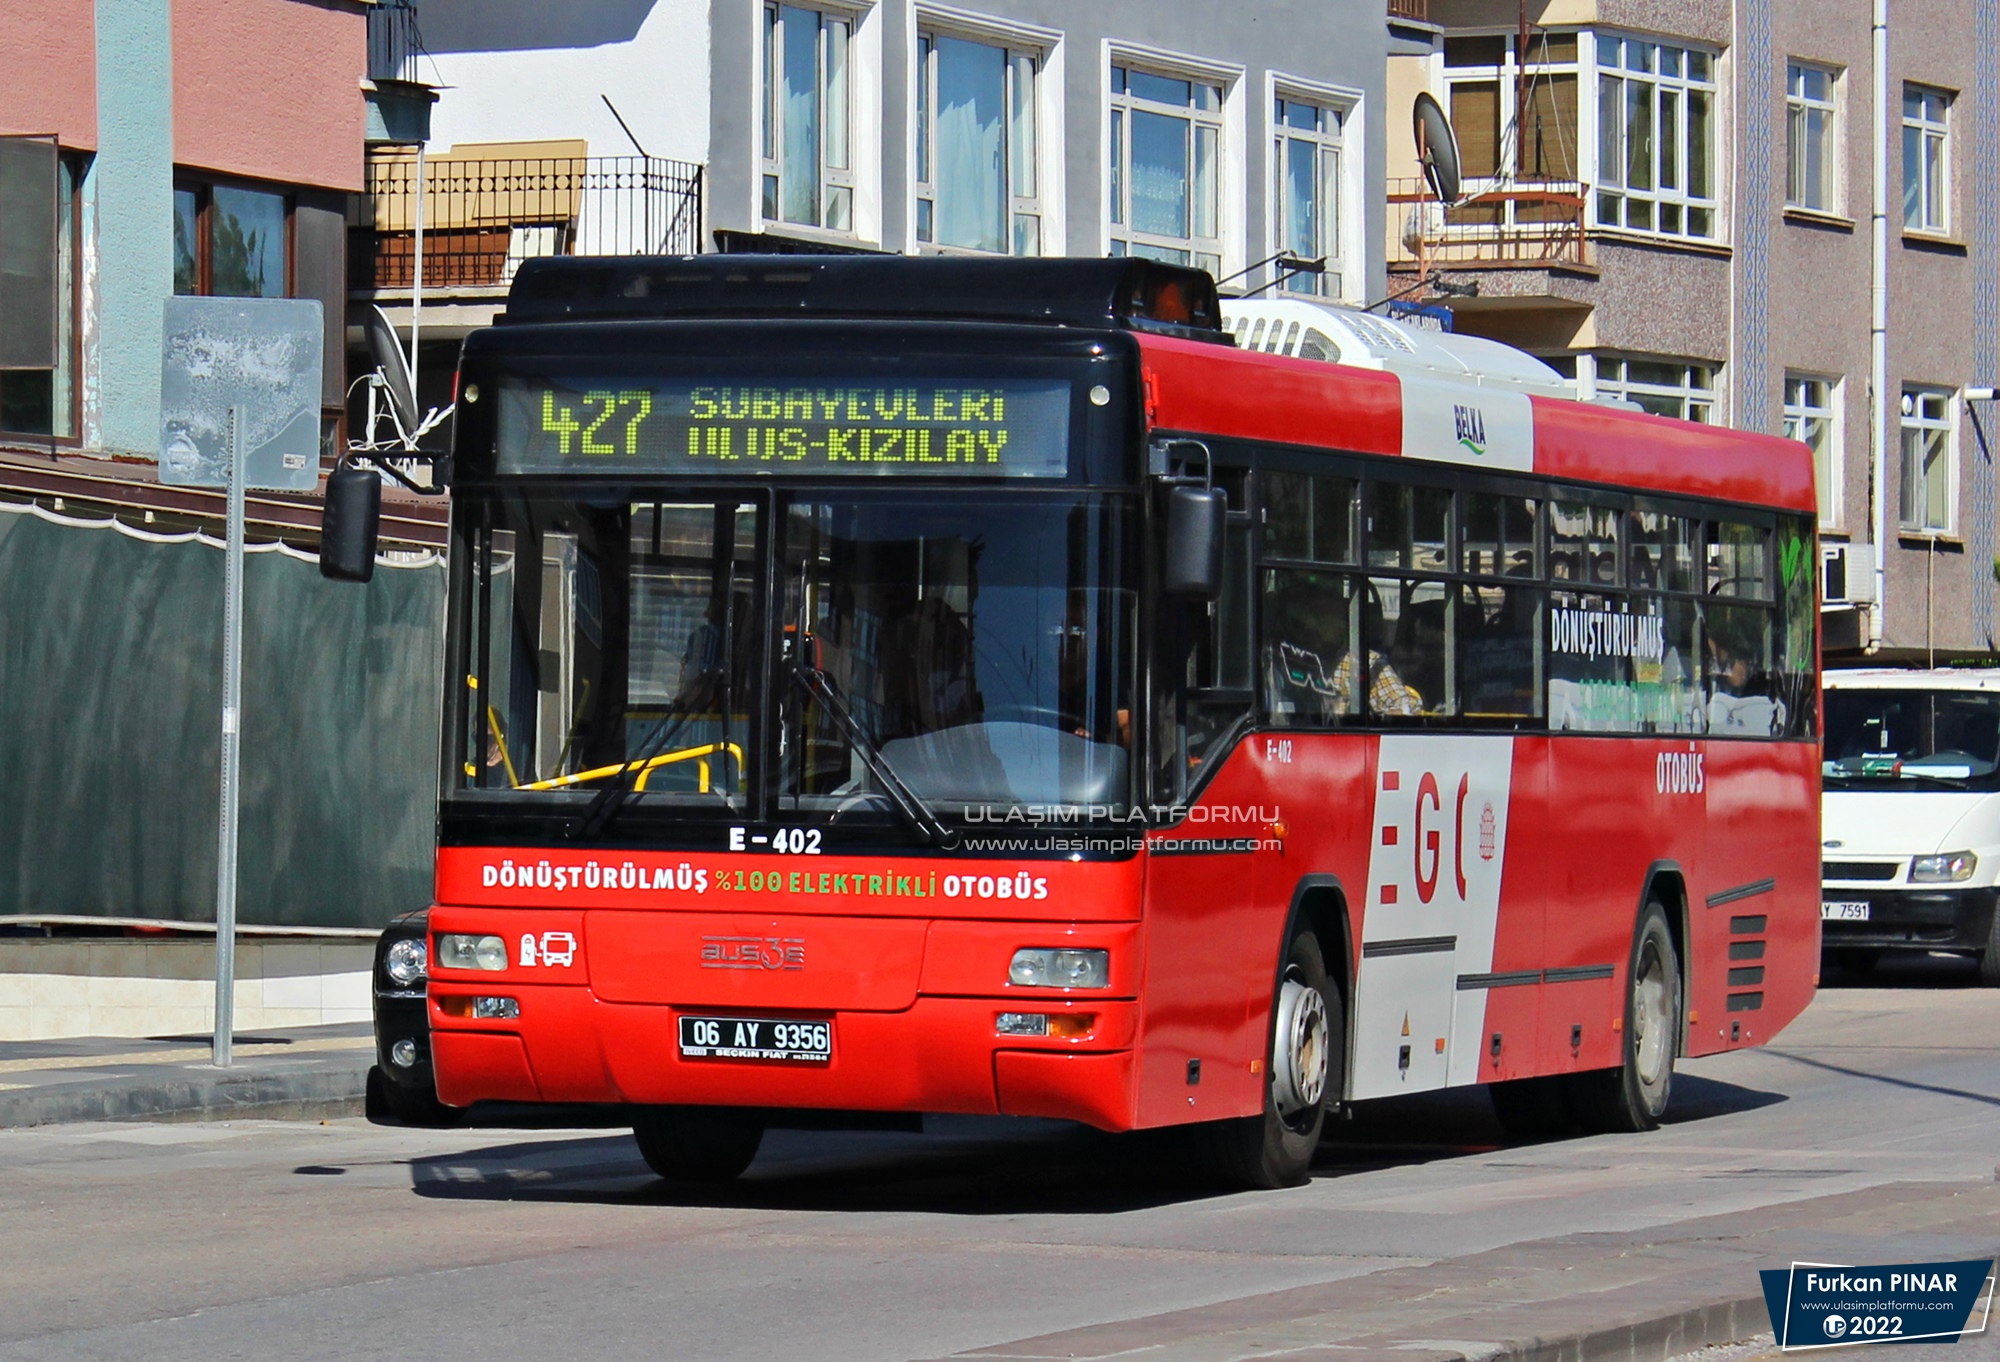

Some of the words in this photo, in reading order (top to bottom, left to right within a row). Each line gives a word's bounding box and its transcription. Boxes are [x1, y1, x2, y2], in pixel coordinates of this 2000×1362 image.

[542, 390, 651, 454] 427
[1453, 404, 1487, 445] BELKA
[1551, 597, 1664, 664] DÖNÜŞTÜRÜLMÜŞ
[1266, 739, 1292, 763] E-402
[1656, 740, 1704, 794] OTOBÜS
[482, 860, 708, 894] DÖNÜŞTÜRÜLMÜŞ
[715, 870, 782, 892] %100
[788, 869, 936, 898] ELEKTRİKLİ
[943, 871, 1049, 900] OTOBÜS
[1839, 904, 1868, 918] 7591
[693, 1020, 720, 1046] 06
[733, 1022, 760, 1048] AY
[773, 1023, 827, 1050] 9356
